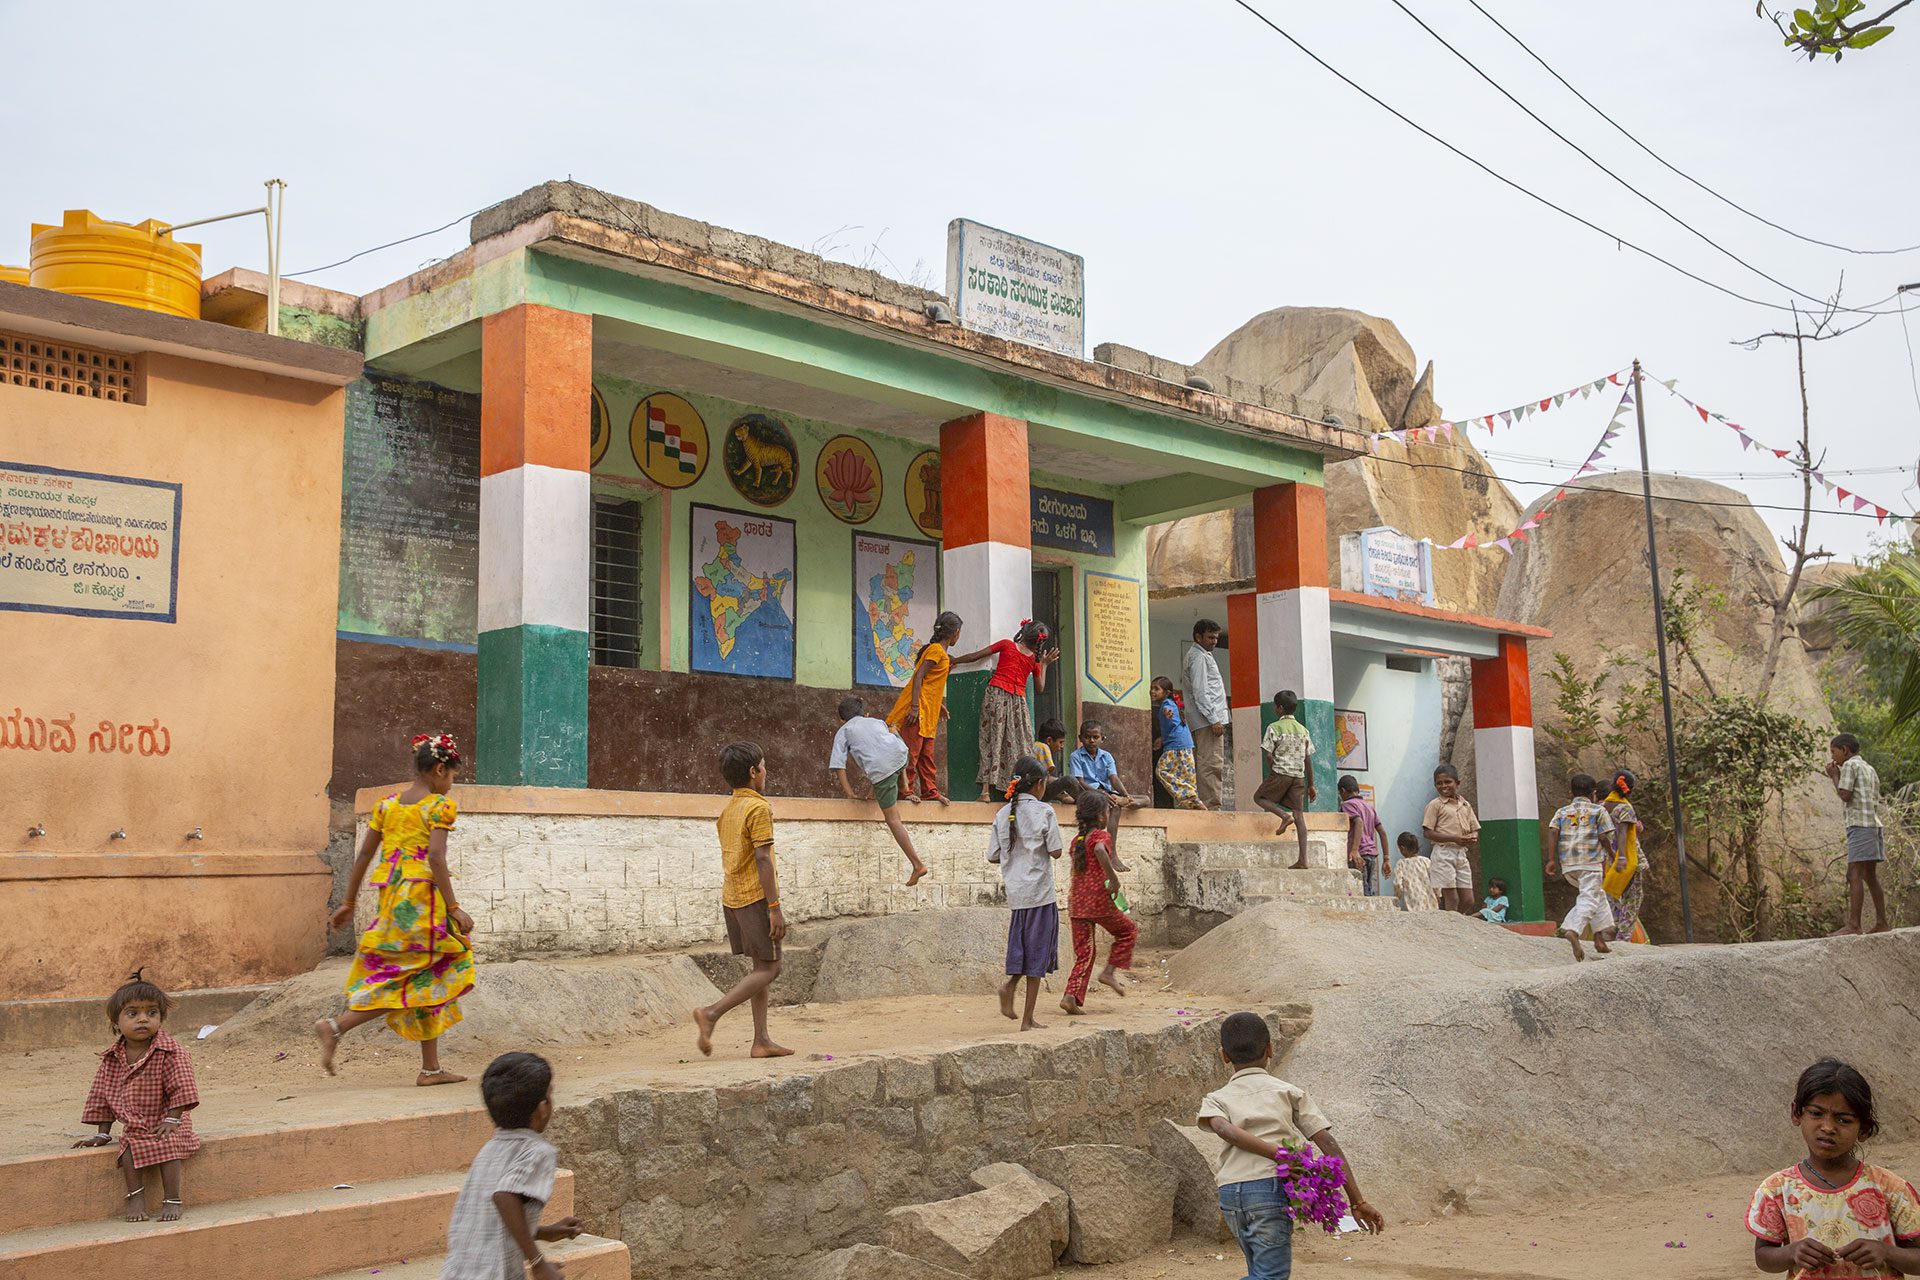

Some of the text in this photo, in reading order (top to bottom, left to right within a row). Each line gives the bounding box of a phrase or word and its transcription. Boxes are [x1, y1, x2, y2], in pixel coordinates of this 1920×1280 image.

[968, 266, 1008, 298] ಸರಕಾರಿ
[744, 520, 773, 538] ಭಾರತ
[88, 717, 171, 757] ನೀರು
